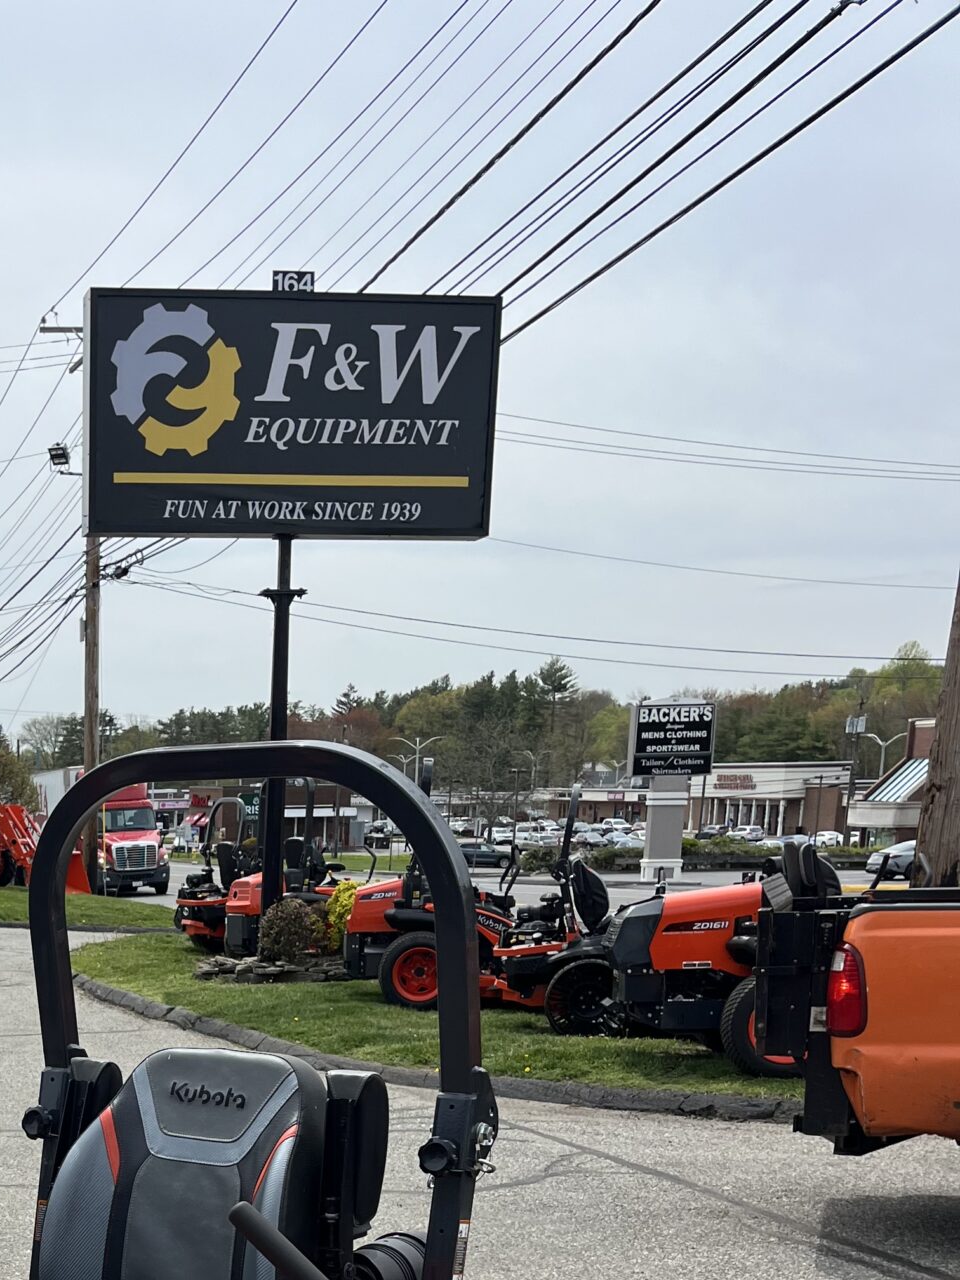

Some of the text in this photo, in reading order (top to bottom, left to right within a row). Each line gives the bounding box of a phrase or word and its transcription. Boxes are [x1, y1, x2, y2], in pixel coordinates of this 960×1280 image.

[274, 272, 313, 291] 164
[254, 322, 481, 405] F&W
[244, 417, 460, 451] EQUIPMENT
[163, 500, 421, 522] FUN AT WORK SINCE 1939
[639, 706, 712, 723] BACKER'S
[641, 730, 707, 739] MENS CLOTHING
[646, 744, 700, 752] SPORTSWEAR
[692, 921, 729, 930] ZD1611
[170, 1081, 246, 1109] Kubota
